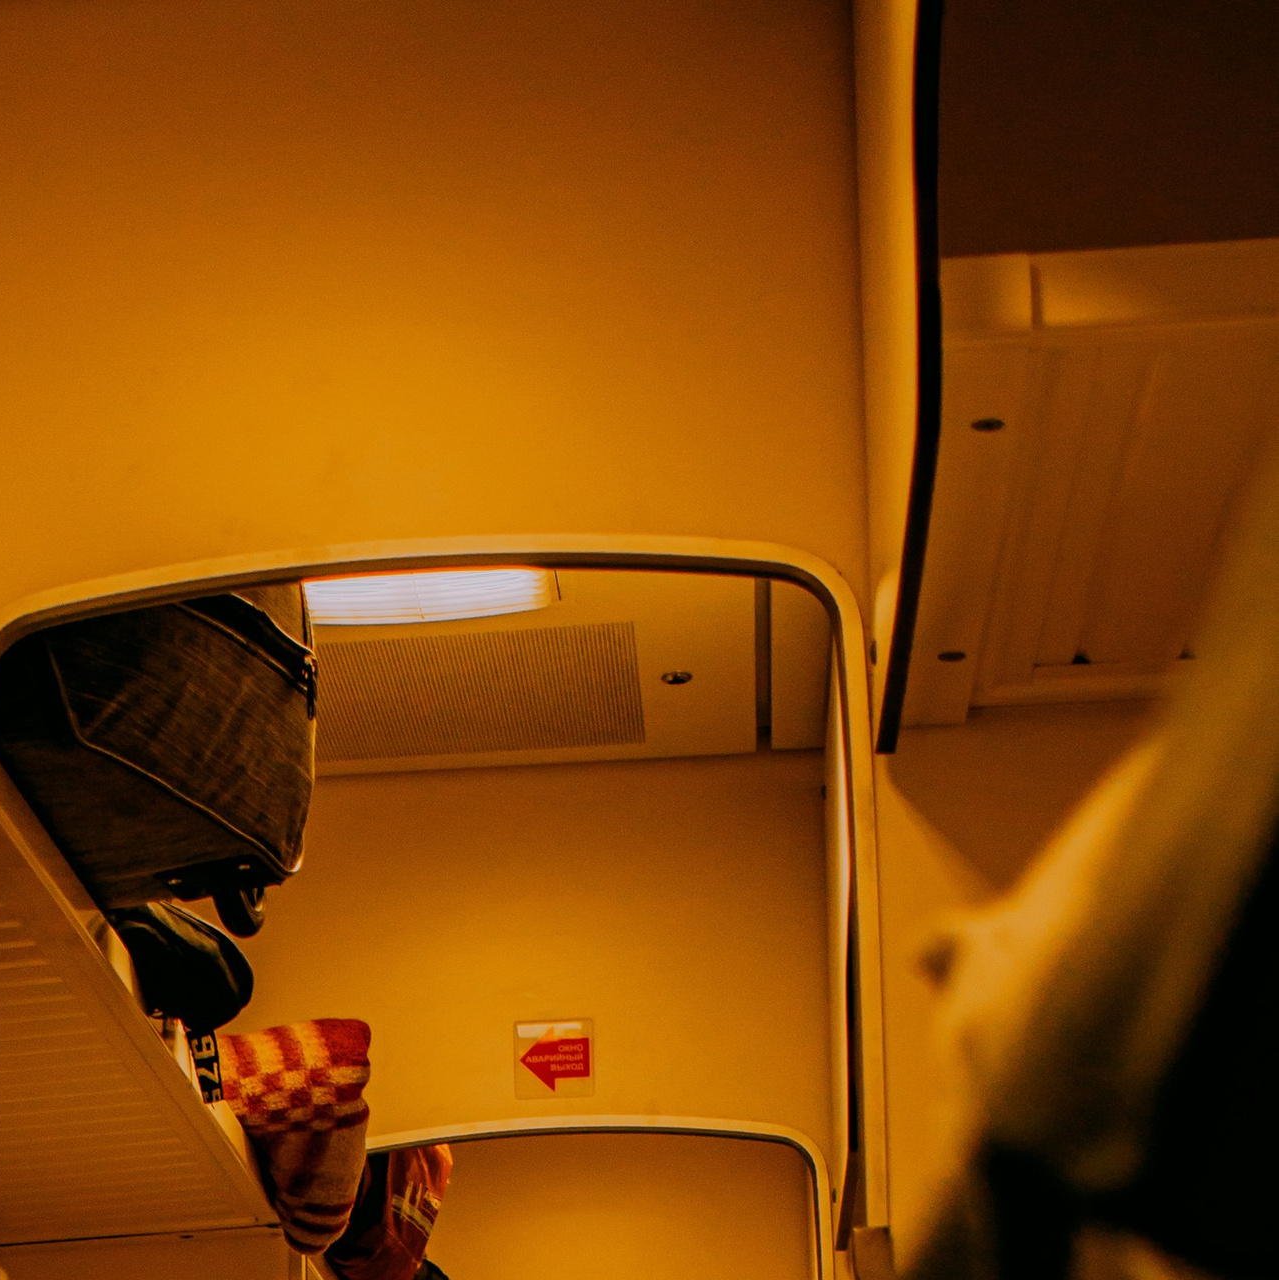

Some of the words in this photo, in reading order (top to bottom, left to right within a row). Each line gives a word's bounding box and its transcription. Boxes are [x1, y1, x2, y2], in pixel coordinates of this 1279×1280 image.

[558, 1043, 584, 1053] ОКНО
[525, 1052, 584, 1063] АВАРИЙНЫЙ
[550, 1062, 584, 1072] ВЫХОД
